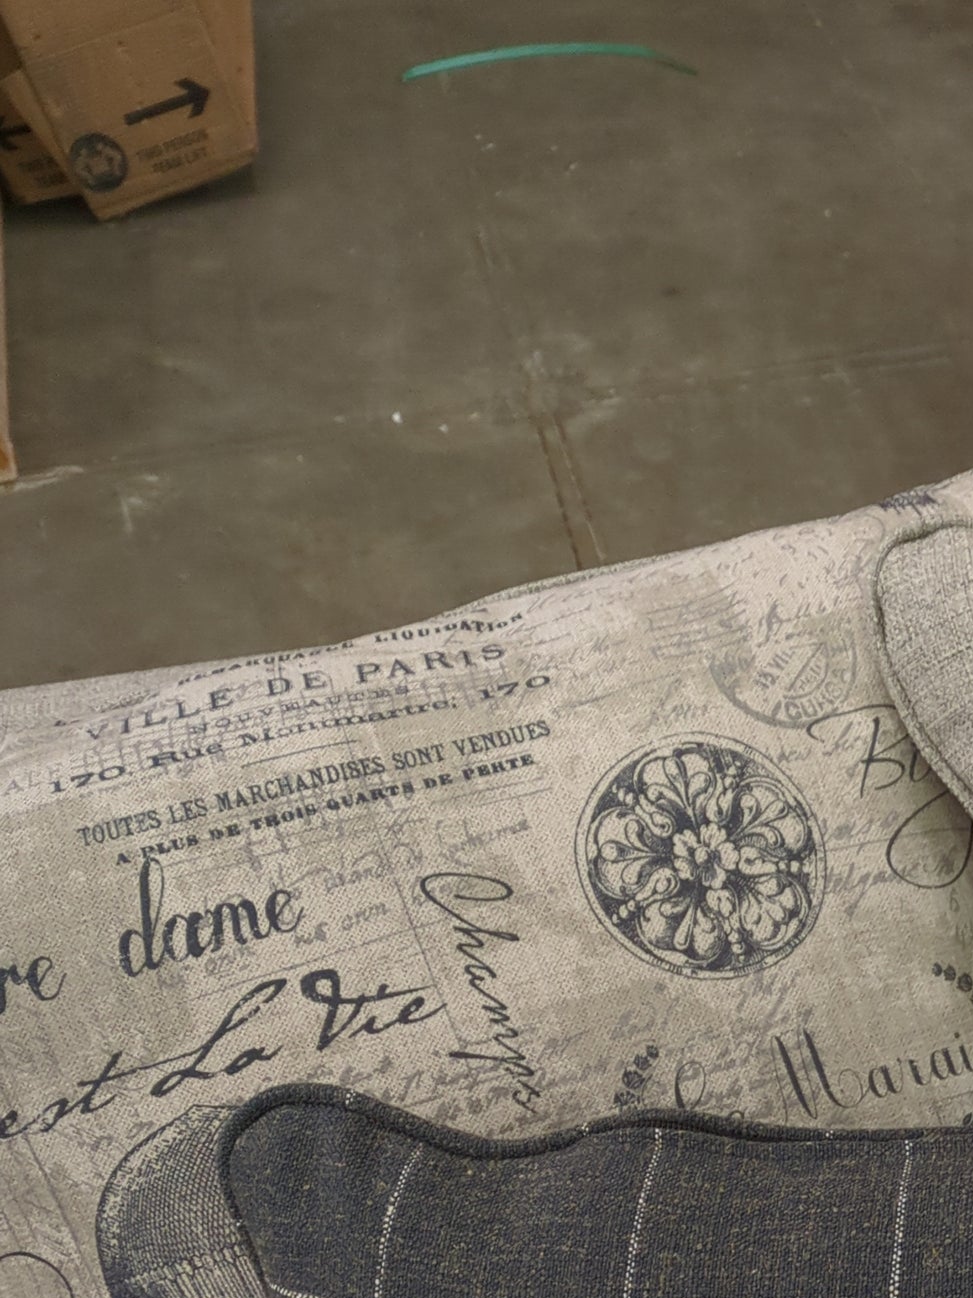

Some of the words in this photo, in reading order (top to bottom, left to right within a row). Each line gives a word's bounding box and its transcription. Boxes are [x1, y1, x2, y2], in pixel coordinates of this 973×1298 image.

[87, 687, 235, 740] VILLE
[267, 668, 329, 698] DE
[354, 643, 506, 685] PARIS
[148, 741, 224, 768] Rue
[478, 674, 552, 701] 170
[77, 810, 162, 847] TOUTES
[168, 798, 209, 825] LES
[214, 757, 386, 813] MARCHANDISES
[391, 742, 445, 770] SONT
[451, 719, 551, 757] VENDUES
[116, 852, 131, 866] A
[140, 834, 199, 860] PLUS
[208, 823, 241, 841] DE
[249, 802, 317, 830] TROIS
[326, 781, 415, 811] QUARTS
[422, 773, 453, 790] DE
[0, 955, 67, 1016] re
[118, 856, 305, 978] dame
[420, 872, 541, 1115] Champs
[150, 977, 284, 1098] La
[300, 967, 448, 1051] Vie
